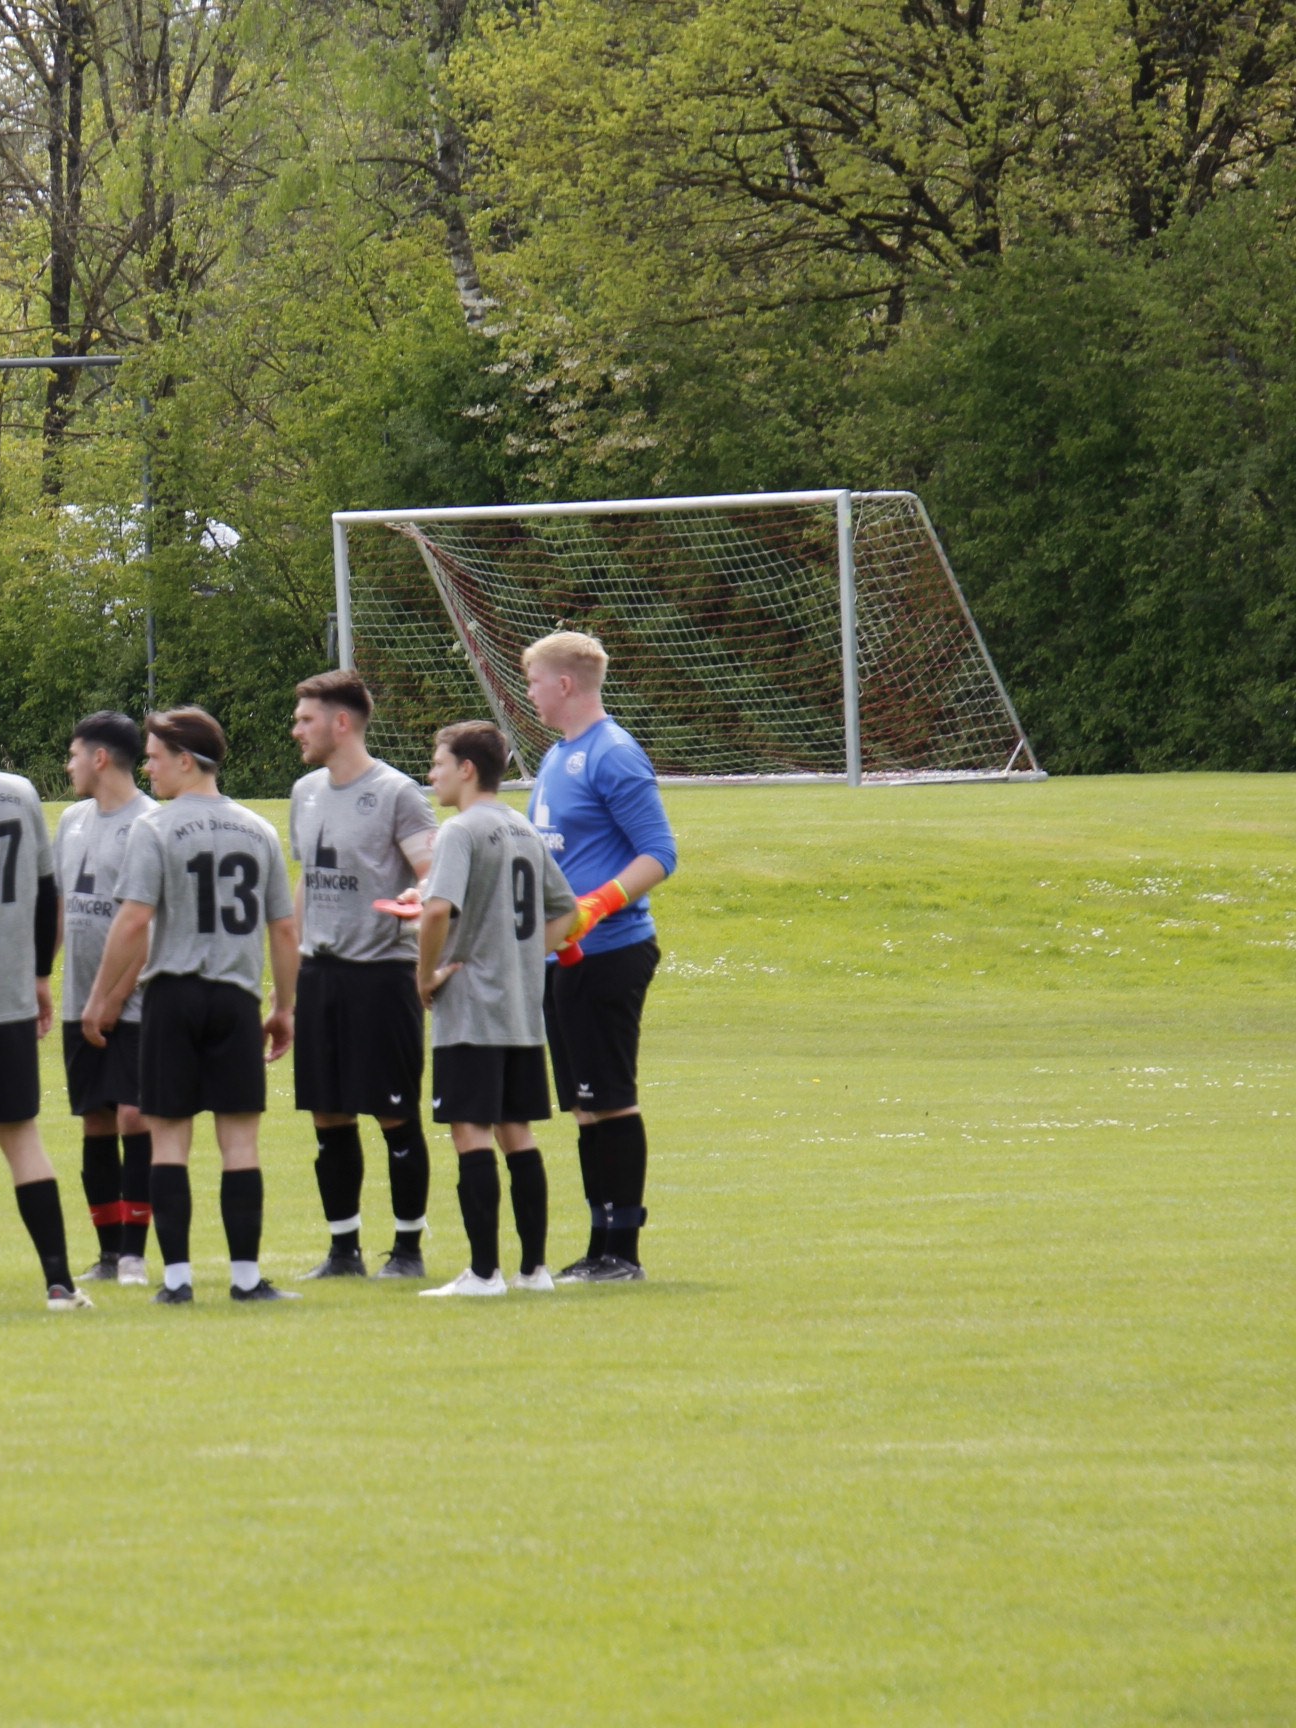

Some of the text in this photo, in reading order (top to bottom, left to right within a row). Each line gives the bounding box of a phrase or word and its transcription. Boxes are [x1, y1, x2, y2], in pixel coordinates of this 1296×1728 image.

[175, 818, 264, 843] MTV Diessen
[186, 850, 260, 936] 13
[512, 856, 536, 941] 9
